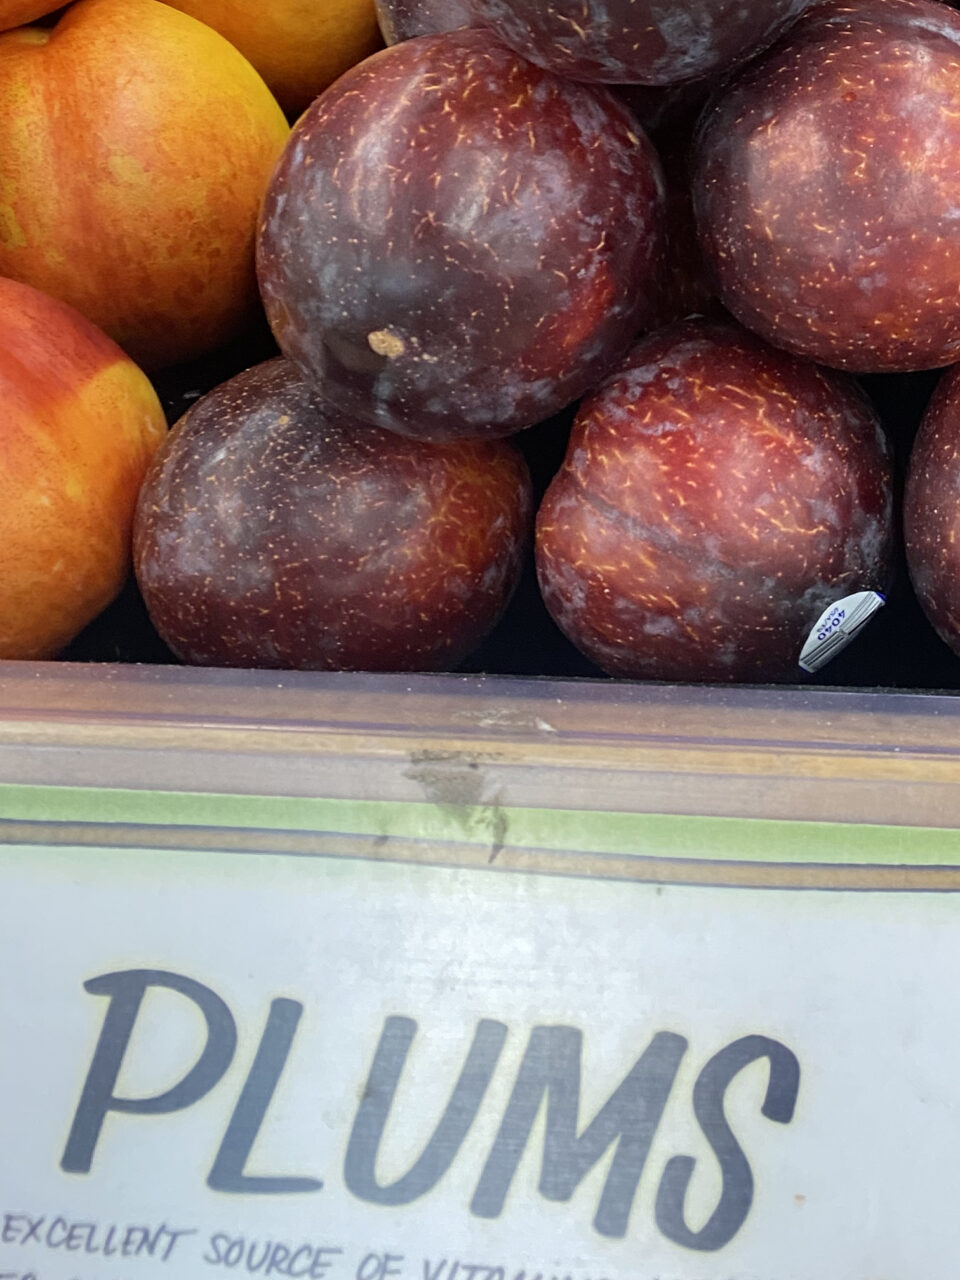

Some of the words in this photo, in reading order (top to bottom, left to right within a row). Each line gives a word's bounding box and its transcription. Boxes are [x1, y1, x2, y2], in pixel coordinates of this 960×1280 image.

[817, 609, 846, 641] 4040
[60, 968, 801, 1252] PLUMS
[2, 1213, 198, 1261] EXCELLENT
[203, 1233, 344, 1280] SOURCE
[356, 1253, 405, 1280] OF
